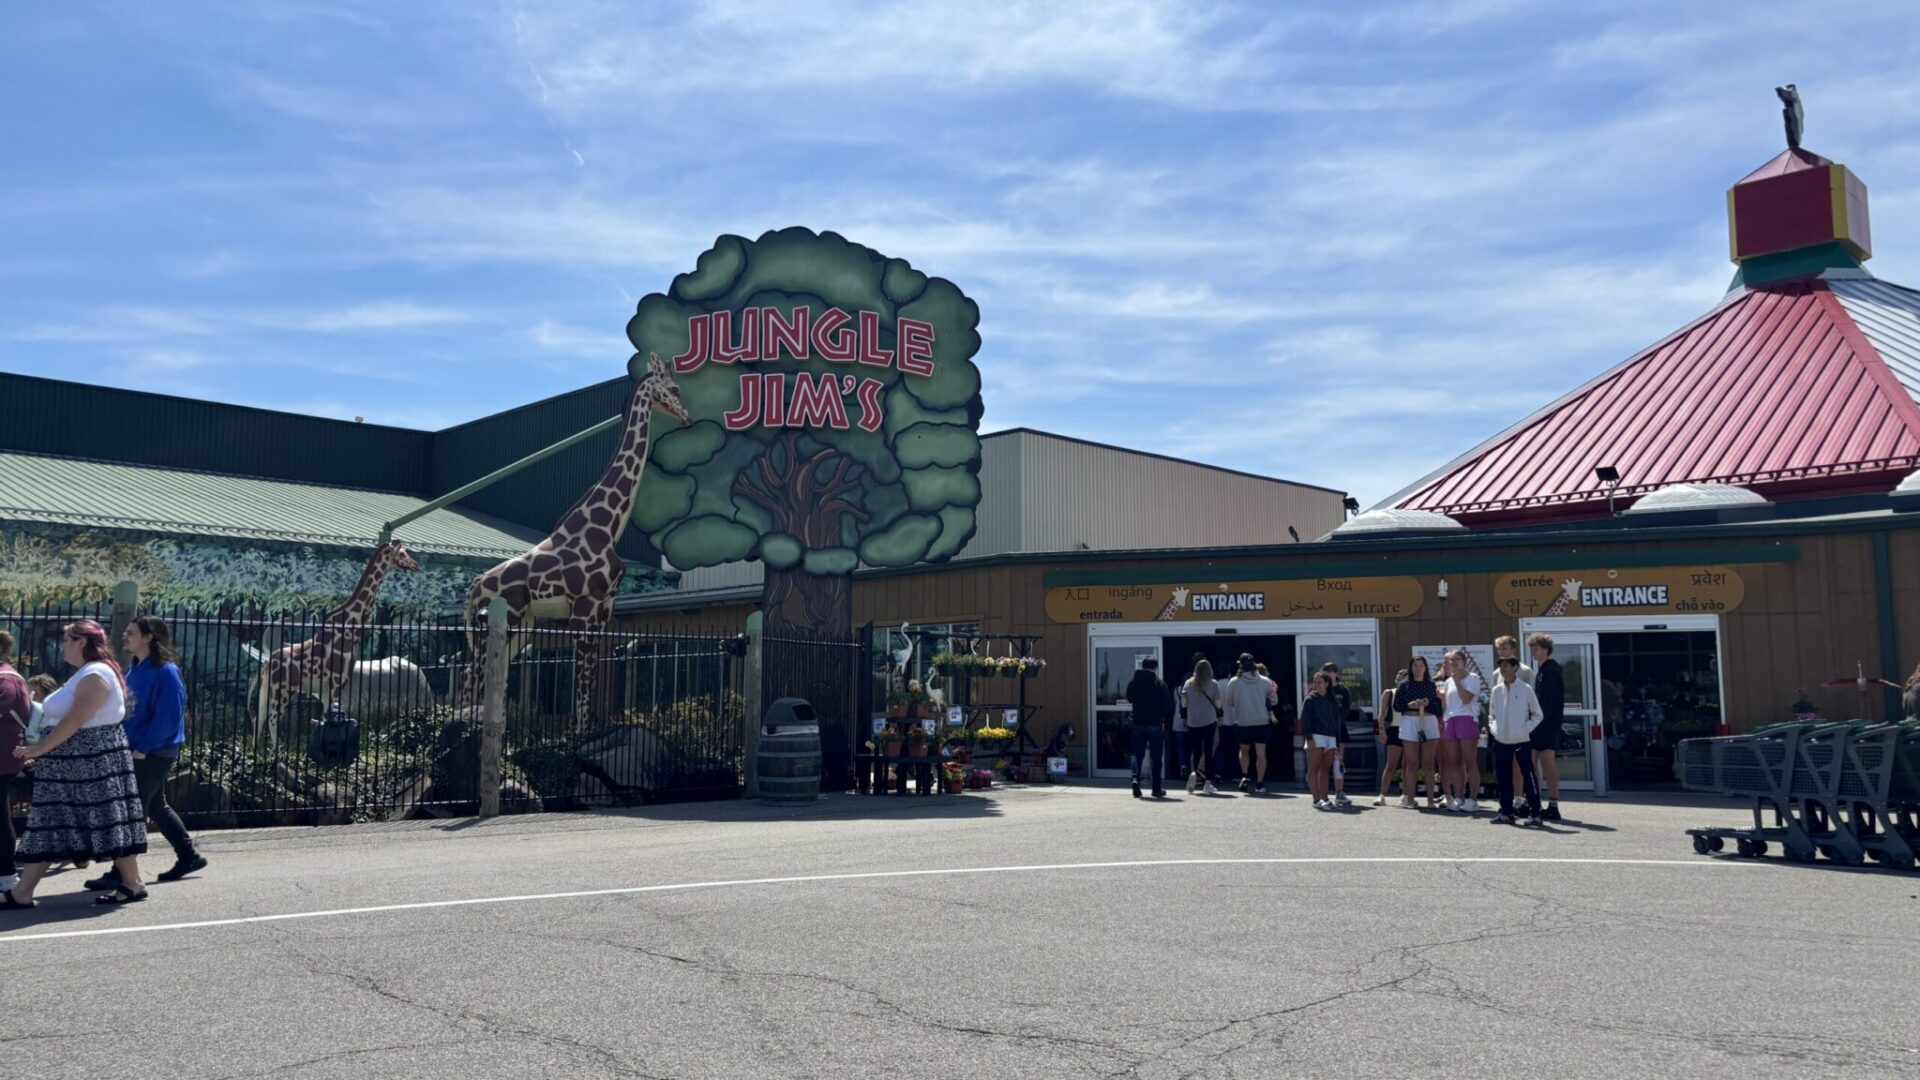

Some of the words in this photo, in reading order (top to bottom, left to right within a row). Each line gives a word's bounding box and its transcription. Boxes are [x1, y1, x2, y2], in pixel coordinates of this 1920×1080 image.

[673, 306, 935, 376] JUNGLE
[724, 372, 884, 432] JIM'S
[1317, 579, 1352, 592] Вход
[1511, 575, 1554, 588] entrée
[1064, 588, 1090, 601] 入口
[1582, 586, 1667, 606] ENTRANCE
[1192, 593, 1264, 611] ENTRANCE
[1347, 601, 1401, 614] Intrare
[1506, 599, 1538, 615] 입구
[1701, 599, 1725, 611] vào
[1079, 609, 1123, 620] entrada
